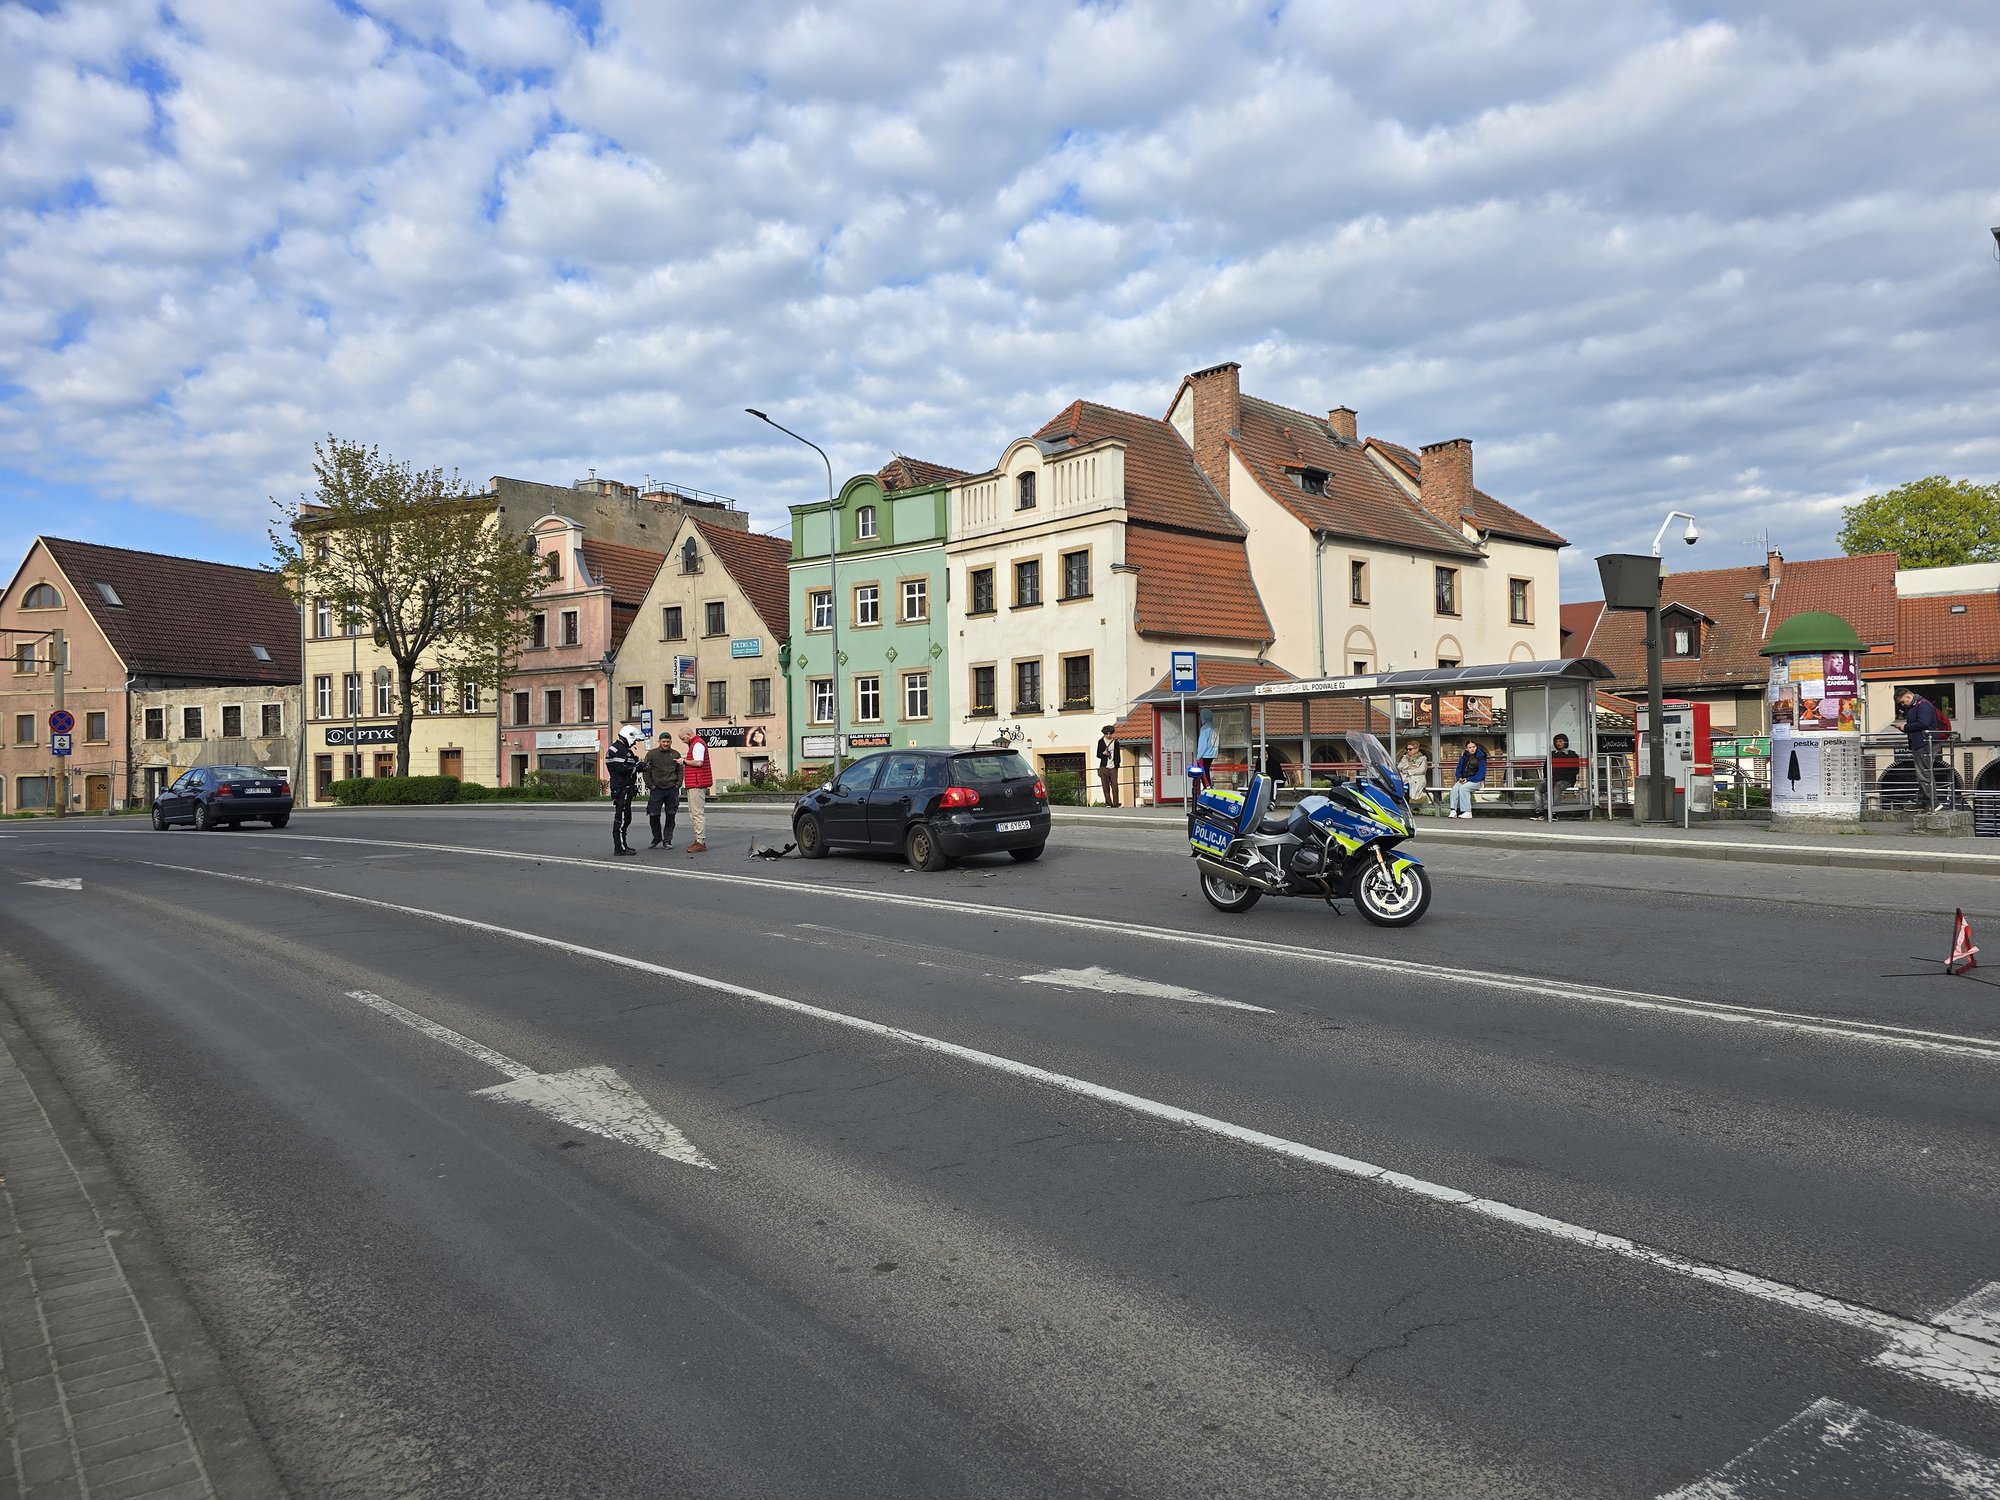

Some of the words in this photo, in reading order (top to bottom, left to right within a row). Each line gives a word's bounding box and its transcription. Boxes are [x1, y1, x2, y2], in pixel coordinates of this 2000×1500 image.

[346, 729, 395, 740] OPTYK
[698, 728, 720, 736] STUDIO
[721, 728, 745, 736] FRYZUR
[707, 736, 728, 747] Diva
[1793, 740, 1819, 748] pestka
[1000, 823, 1009, 832] DW
[1194, 825, 1227, 848] POLICJA
